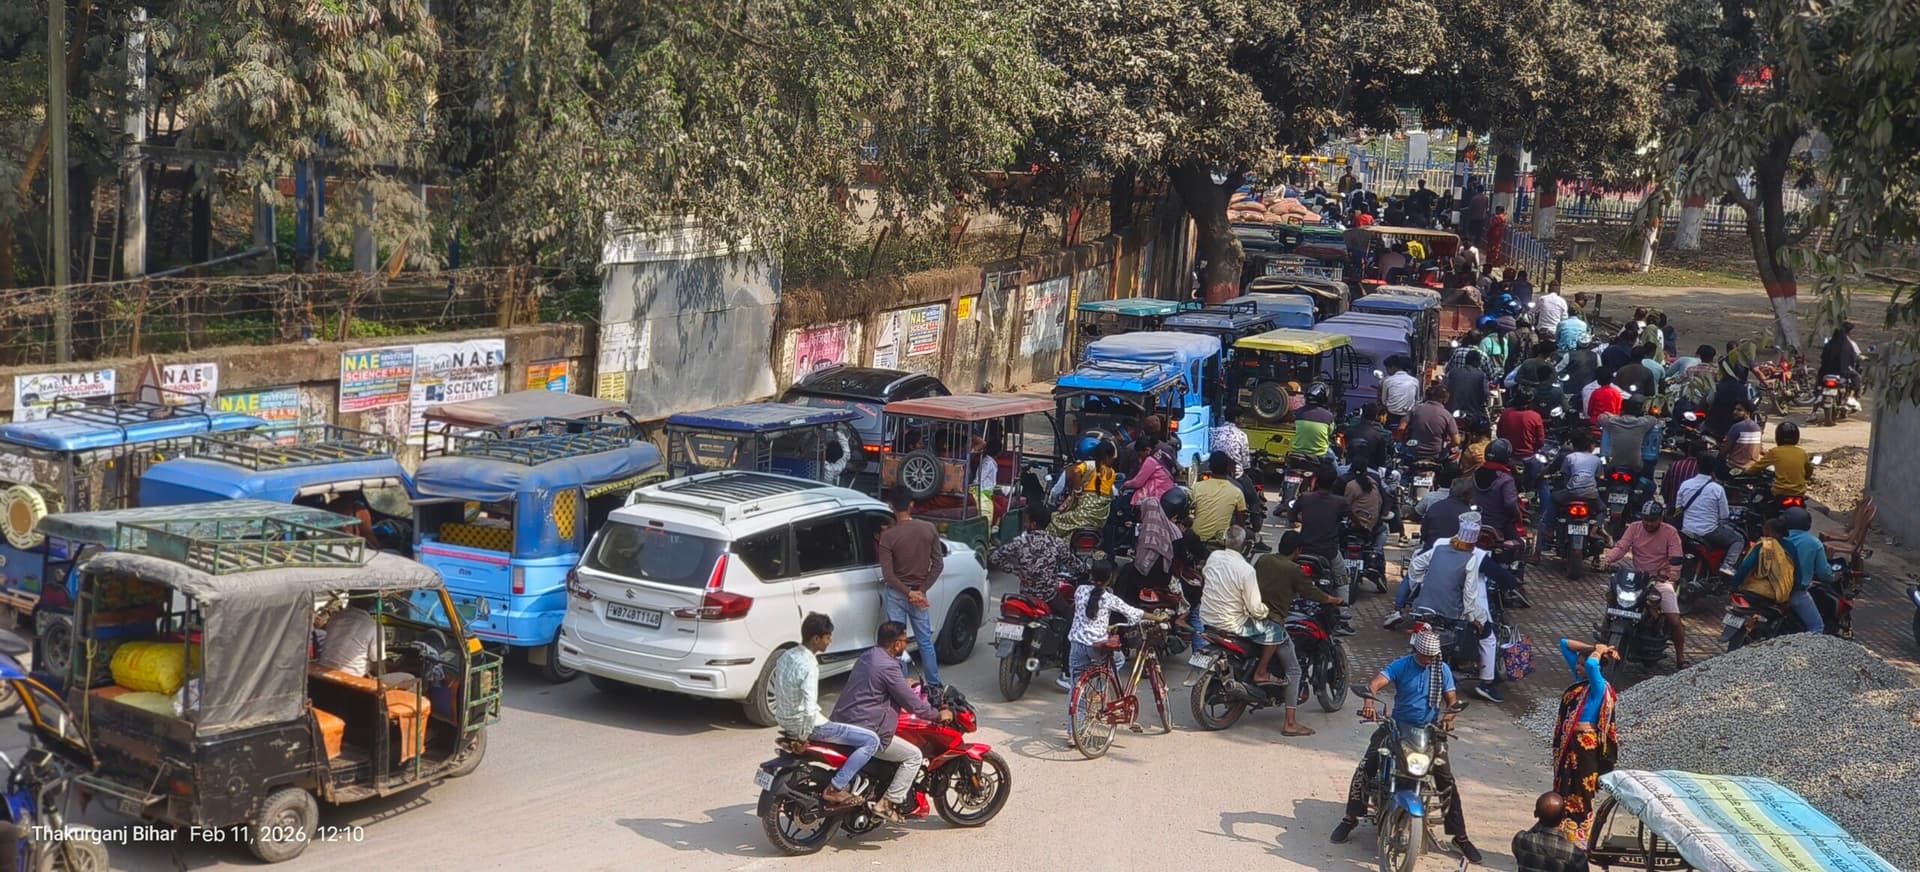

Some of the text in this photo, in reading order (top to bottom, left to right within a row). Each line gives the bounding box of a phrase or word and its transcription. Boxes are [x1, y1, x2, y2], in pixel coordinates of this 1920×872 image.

[911, 311, 926, 324] NAE
[345, 354, 380, 370] NAE
[453, 351, 494, 368] NAE
[62, 372, 101, 385] NAE
[164, 369, 202, 383] NAE
[346, 369, 388, 381] SCIENCE
[63, 383, 105, 393] COACHING
[446, 380, 494, 395] SCIENCE
[220, 394, 259, 412] NAE
